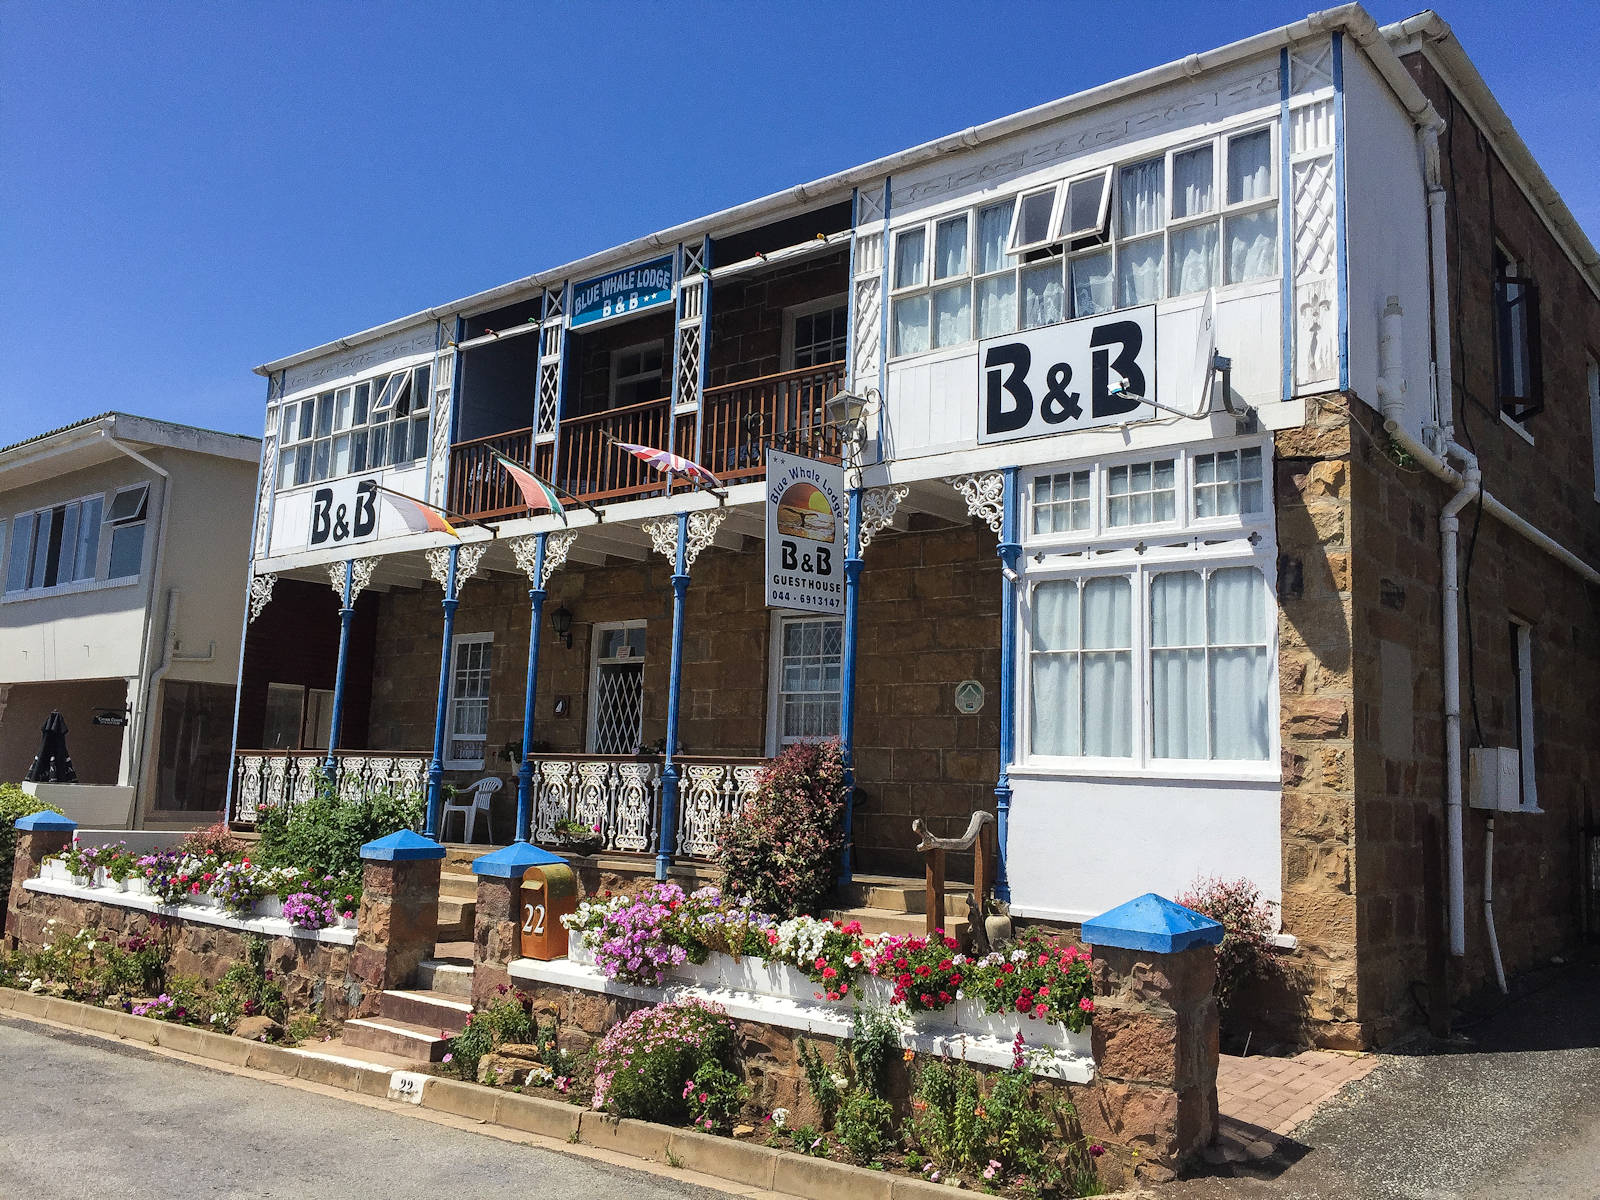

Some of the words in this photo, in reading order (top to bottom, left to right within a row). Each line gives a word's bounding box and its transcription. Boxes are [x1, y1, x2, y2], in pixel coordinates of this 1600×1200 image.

[575, 284, 600, 315] BLUE
[602, 271, 635, 297] WHALE
[637, 269, 671, 290] LODGE
[984, 320, 1146, 435] B&B
[311, 479, 377, 545] B&B
[770, 477, 788, 505] Blue
[788, 466, 820, 483] Whale
[822, 479, 842, 519] Lodge
[781, 540, 832, 576] B&B
[772, 590, 790, 602] 044
[800, 594, 840, 608] 6913147
[522, 903, 545, 934] 22
[399, 1079, 413, 1095] 22
